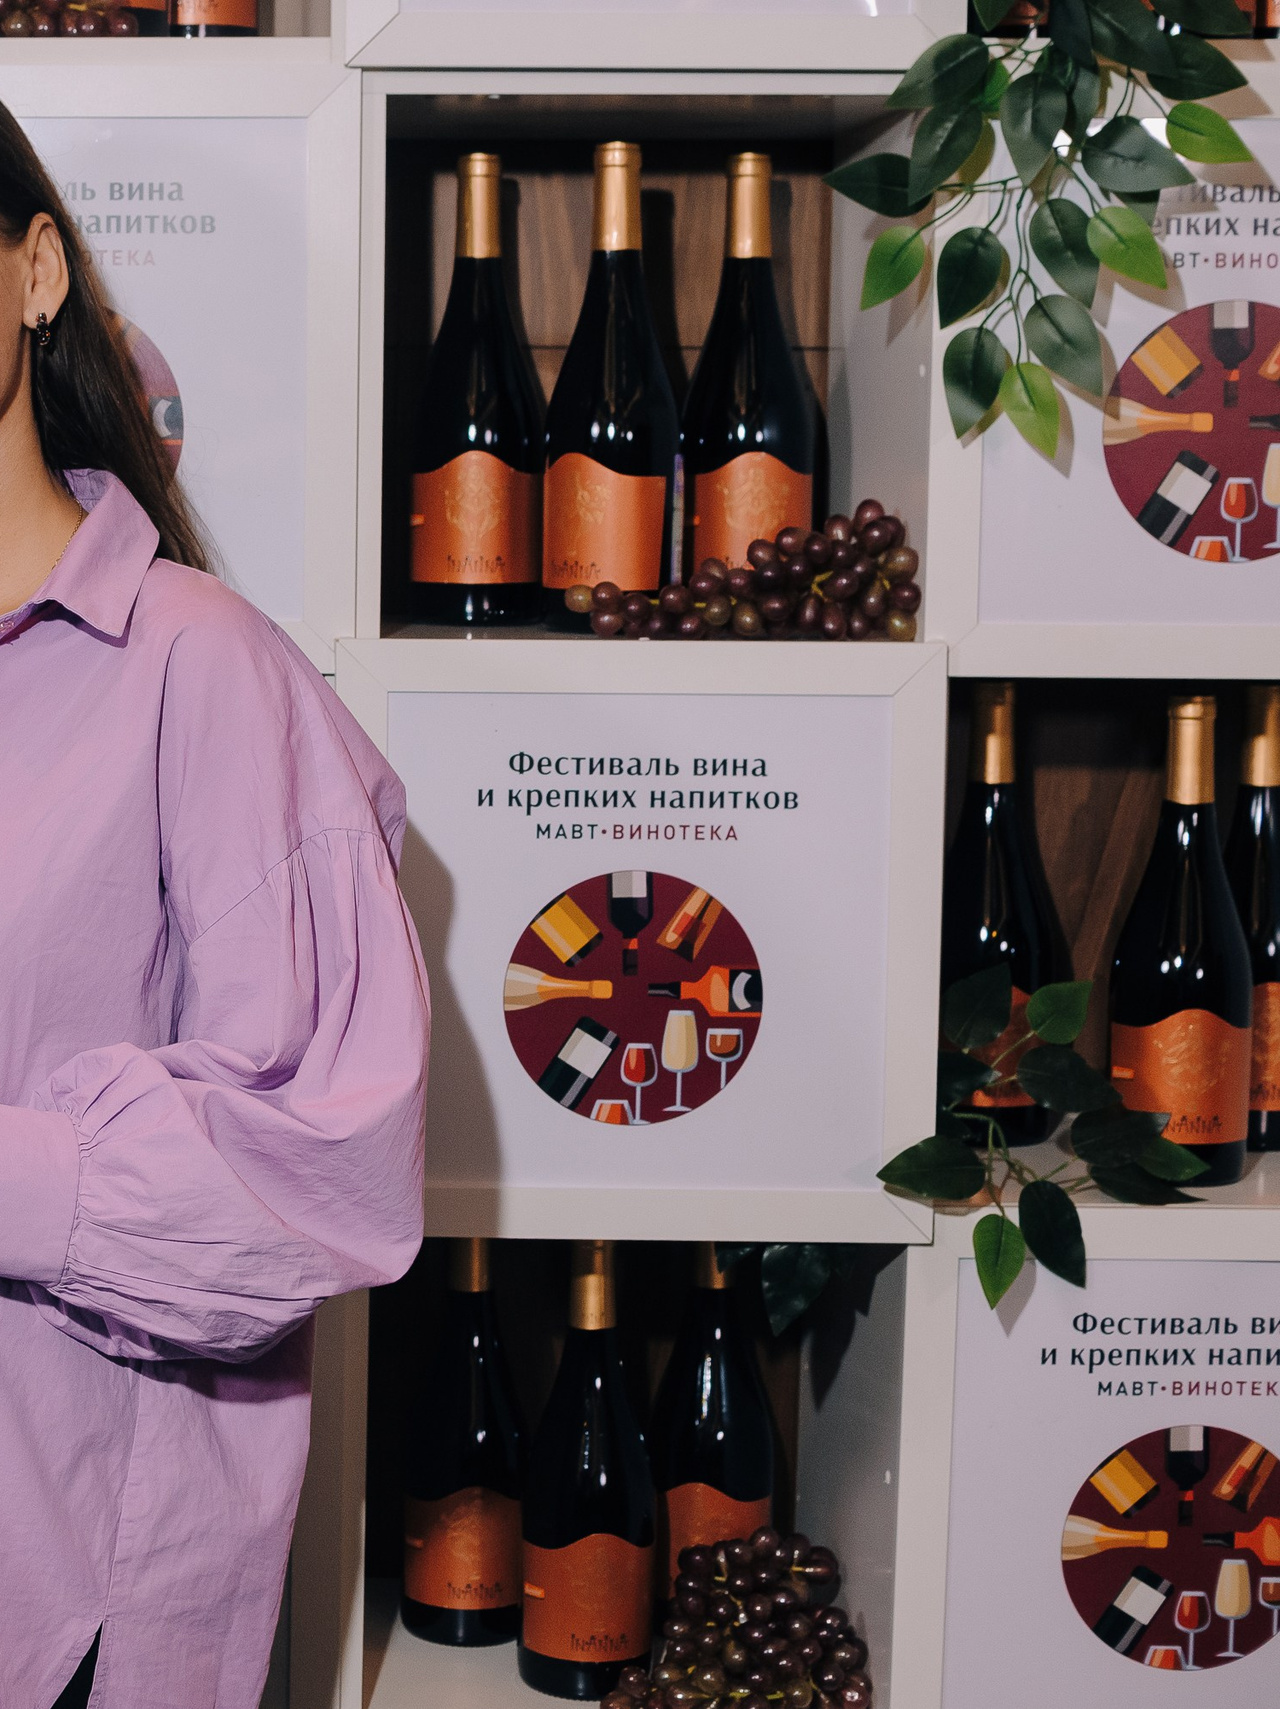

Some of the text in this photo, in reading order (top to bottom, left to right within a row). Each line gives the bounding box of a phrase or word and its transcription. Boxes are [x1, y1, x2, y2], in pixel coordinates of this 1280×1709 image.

[109, 181, 184, 201] вина
[508, 752, 768, 777] Фестиваль вина
[477, 788, 799, 816] и крепких напитков
[1072, 1312, 1238, 1335] Фестиваль
[1041, 1347, 1058, 1365] и
[1070, 1348, 1196, 1374] крепких
